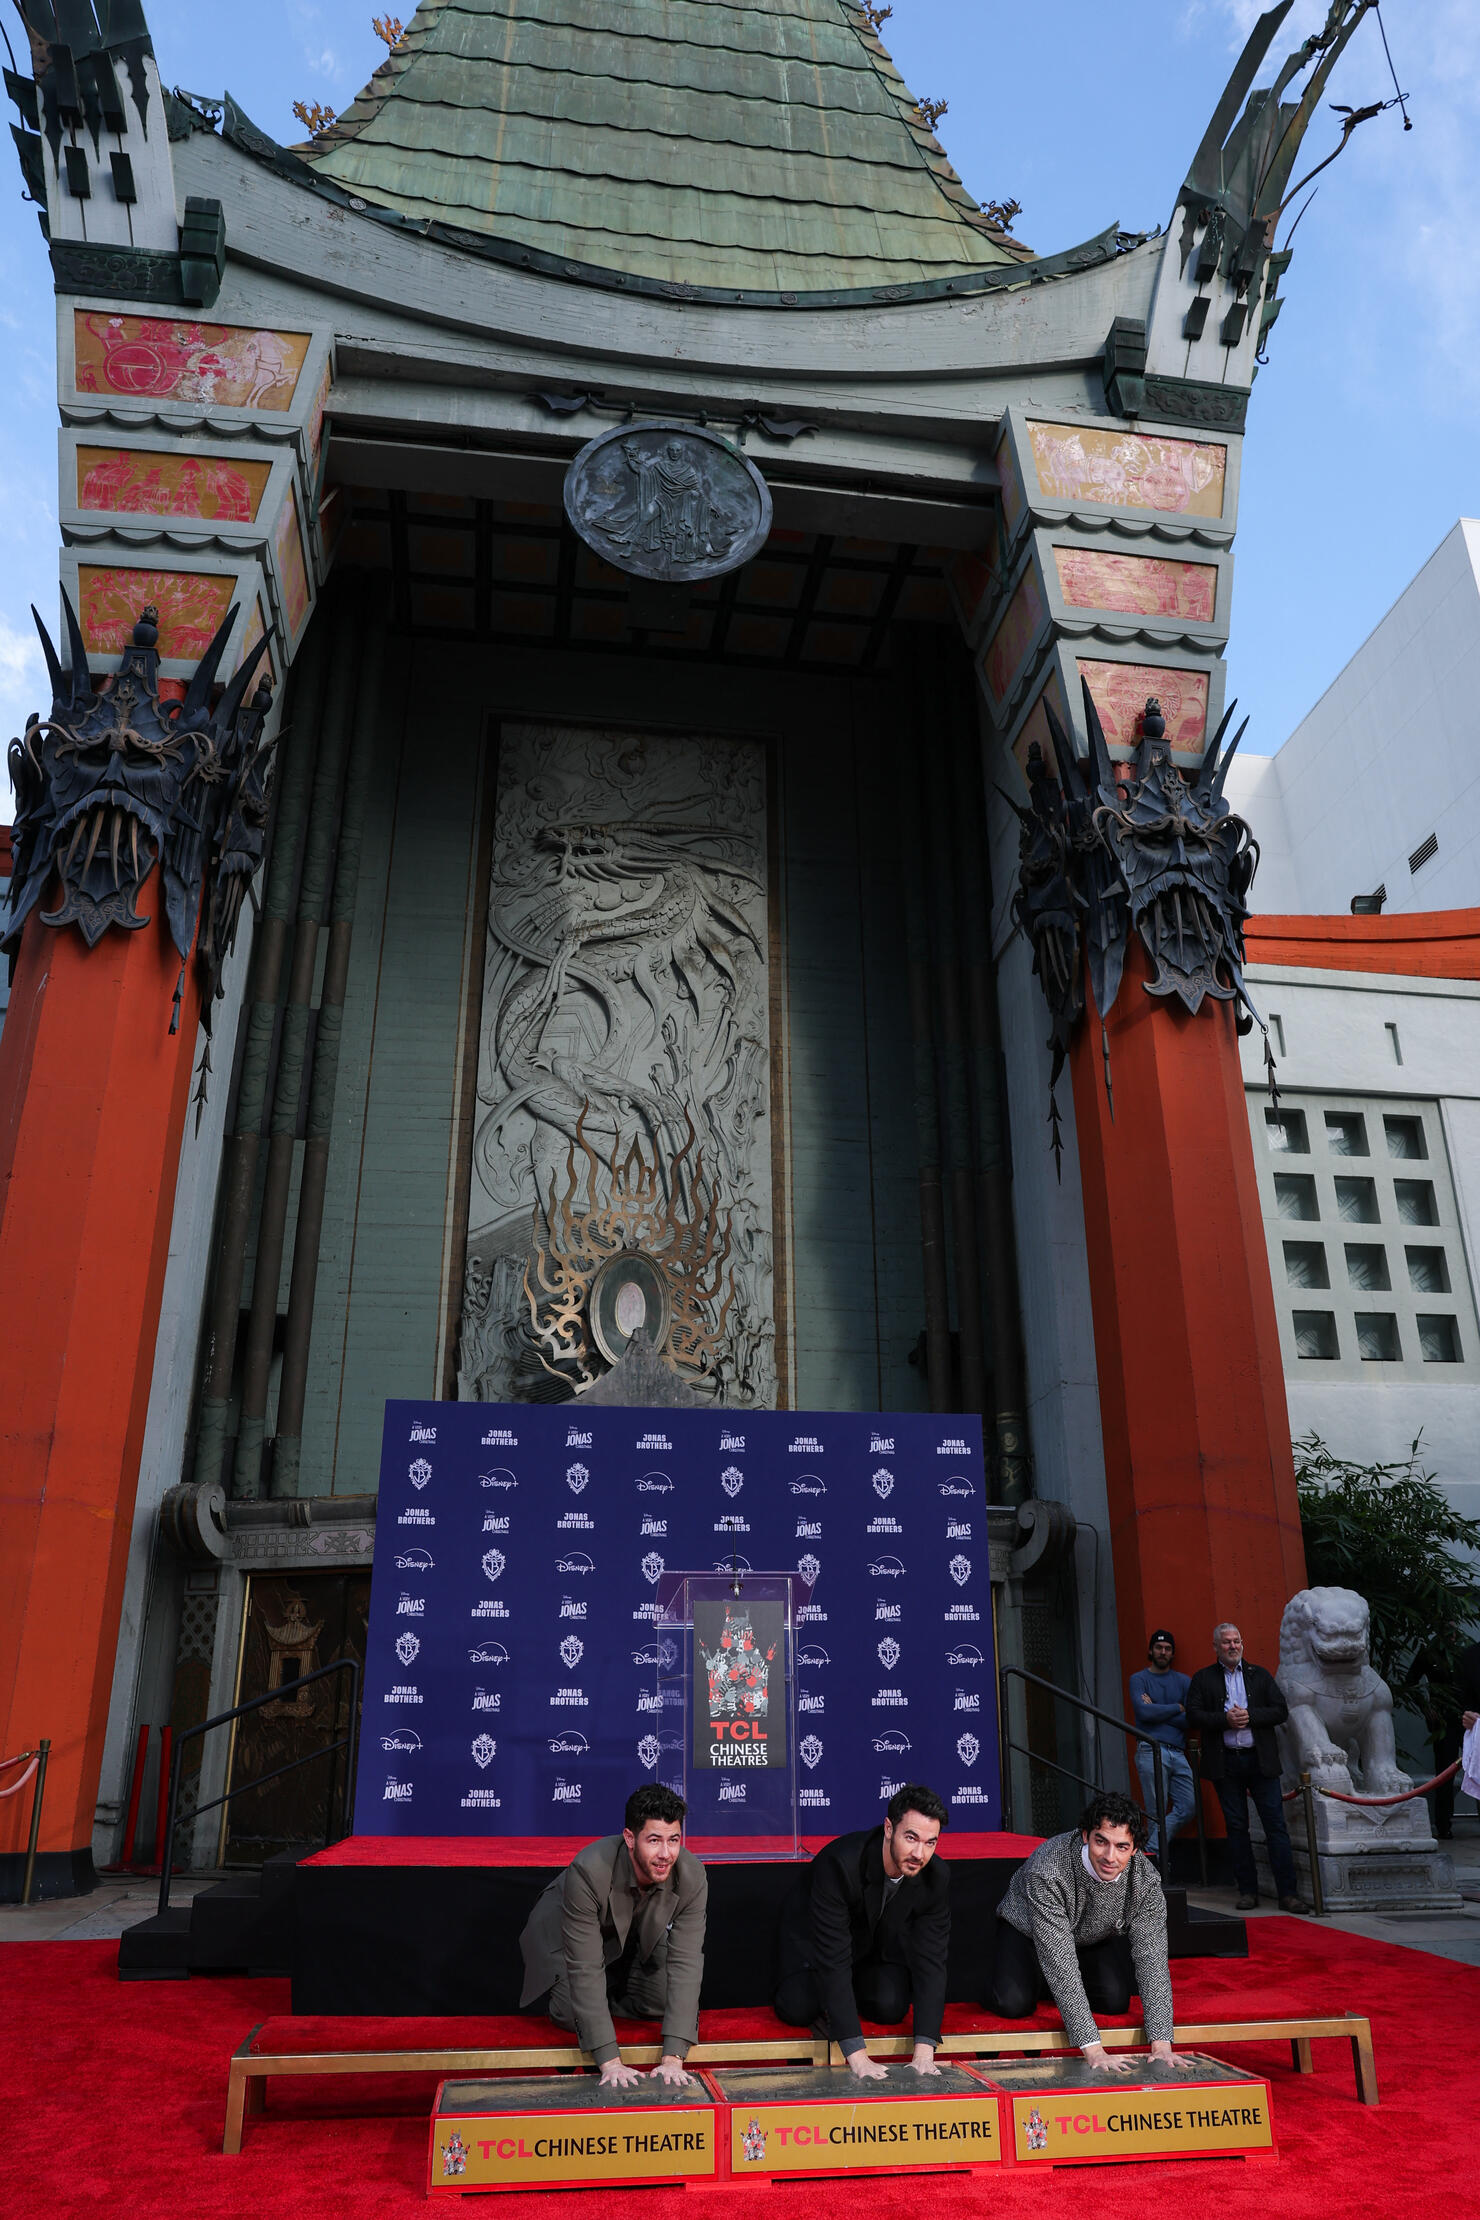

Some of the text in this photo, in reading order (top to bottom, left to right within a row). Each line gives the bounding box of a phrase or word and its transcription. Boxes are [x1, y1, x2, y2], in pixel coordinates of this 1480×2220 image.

[409, 1427, 437, 1442] JONAS
[488, 1430, 512, 1438] JONAS
[642, 1434, 666, 1442] JONAS
[480, 1437, 518, 1446] BROTHERS
[565, 1432, 592, 1447] JONAS
[719, 1436, 745, 1450] JONAS
[794, 1436, 818, 1445] JONAS
[942, 1438, 966, 1447] JONAS
[636, 1441, 672, 1450] BROTHERS
[788, 1444, 824, 1454] BROTHERS
[869, 1438, 895, 1452] JONAS
[936, 1446, 972, 1454] BROTHERS
[404, 1508, 430, 1517] JONAS
[564, 1512, 588, 1521] JONAS
[398, 1516, 436, 1526] BROTHERS
[482, 1517, 510, 1531] JONAS
[556, 1520, 594, 1530] BROTHERS
[720, 1516, 744, 1524] JONAS
[872, 1516, 896, 1525] JONAS
[640, 1520, 667, 1535] JONAS
[795, 1522, 822, 1537] JONAS
[866, 1524, 902, 1534] BROTHERS
[946, 1523, 971, 1538] JONAS
[396, 1599, 425, 1614] JONAS
[478, 1600, 504, 1609] JONAS
[950, 1604, 974, 1613] JONAS
[470, 1608, 510, 1618] BROTHERS
[559, 1602, 587, 1618] JONAS
[875, 1605, 901, 1620] JONAS
[944, 1612, 980, 1622] BROTHERS
[392, 1686, 418, 1695] JONAS
[556, 1688, 582, 1697] JONAS
[878, 1688, 902, 1698] JONAS
[384, 1694, 424, 1704] BROTHERS
[471, 1694, 501, 1711] JONAS
[550, 1696, 590, 1706] BROTHERS
[636, 1695, 663, 1712] JONAS
[798, 1696, 824, 1711] JONAS
[872, 1697, 908, 1706] BROTHERS
[953, 1694, 979, 1711] JONAS
[710, 1720, 768, 1740] TCL
[710, 1743, 768, 1756] CHINESE
[710, 1755, 768, 1767] THEATRES
[383, 1783, 413, 1800] JONAS
[468, 1790, 494, 1799] JONAS
[552, 1784, 582, 1801] JONAS
[718, 1784, 746, 1801] JONAS
[800, 1789, 824, 1798] JONAS
[958, 1786, 982, 1795] JONAS
[460, 1798, 502, 1808] BROTHERS
[799, 1797, 831, 1807] OTHERS
[952, 1794, 988, 1804] BROTHERS
[1055, 2108, 1262, 2135] TCL CHINESE THEATRE
[775, 2121, 992, 2146] TCL CHINESE THEATRE
[477, 2132, 705, 2160] TCL CHINESE THEATRE
